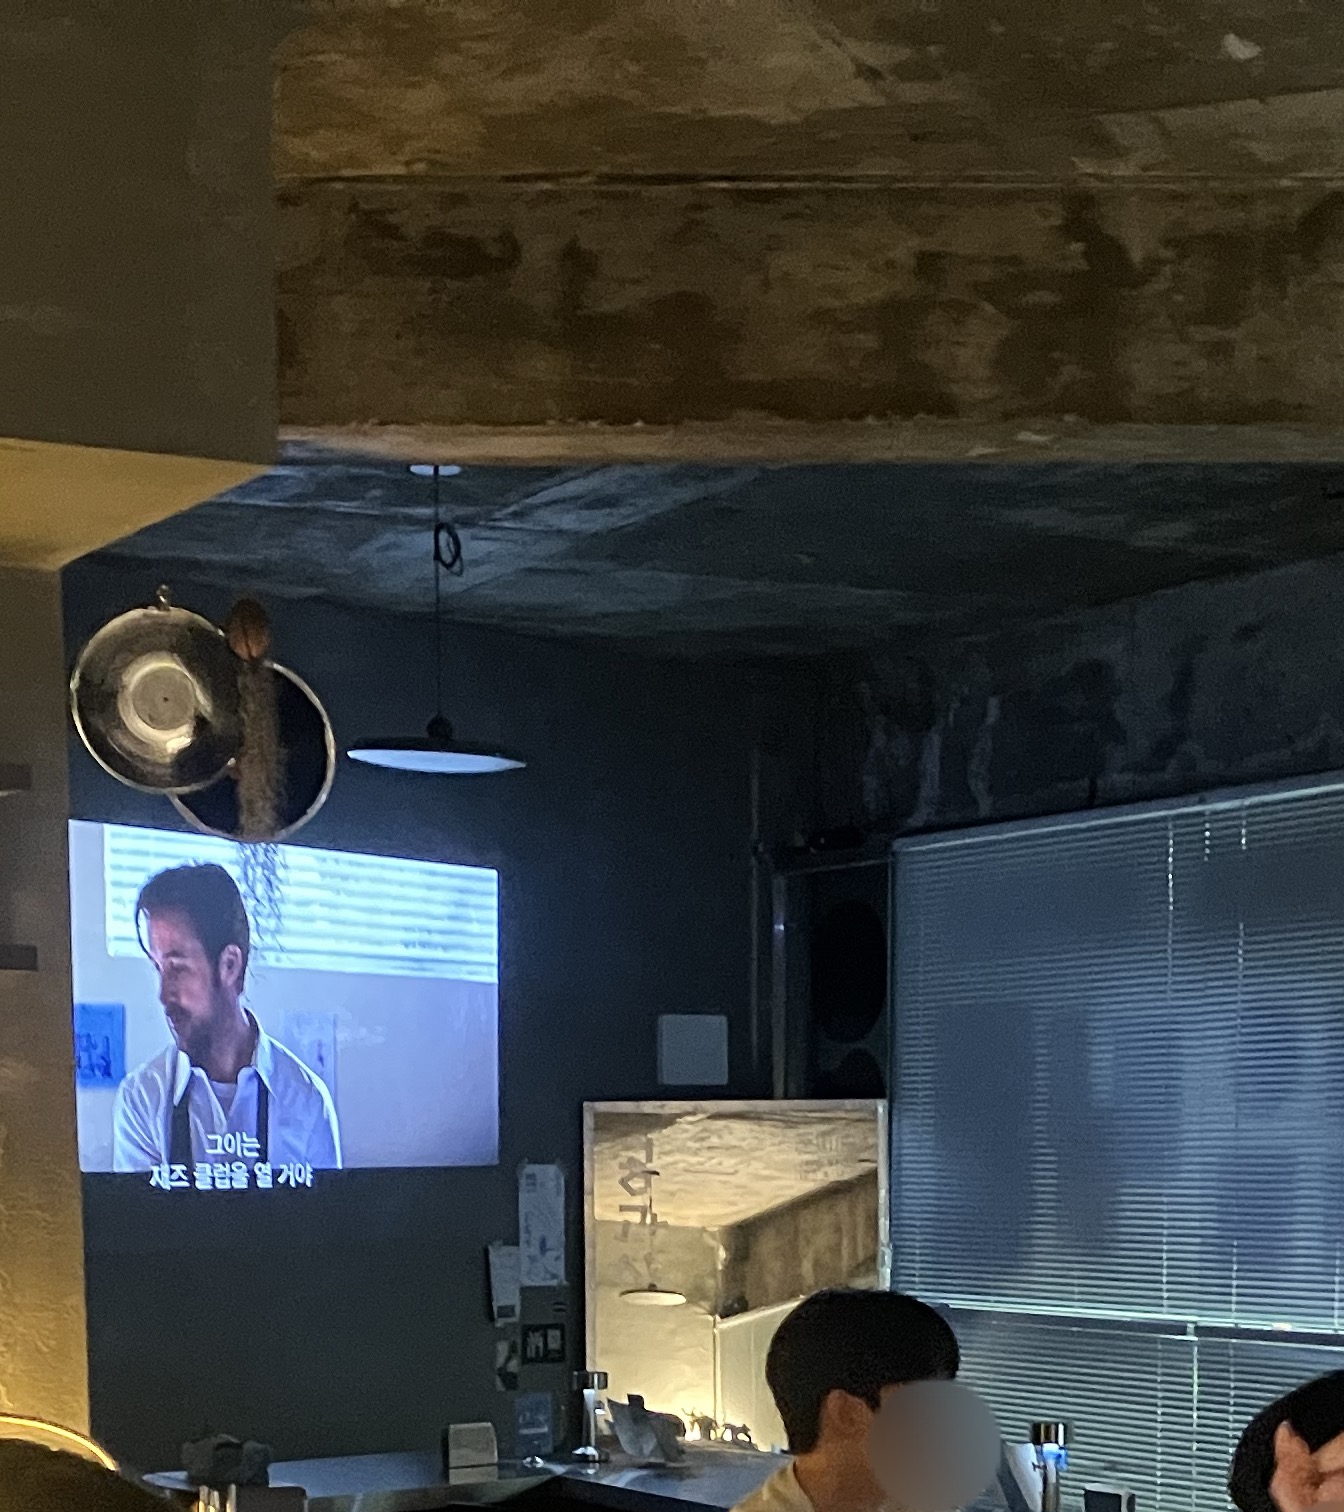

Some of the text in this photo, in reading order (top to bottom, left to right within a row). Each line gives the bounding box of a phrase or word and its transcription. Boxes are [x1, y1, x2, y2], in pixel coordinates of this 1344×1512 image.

[206, 1131, 261, 1158] 그이는
[149, 1161, 313, 1191] 재즈 클럽을 열 거야
